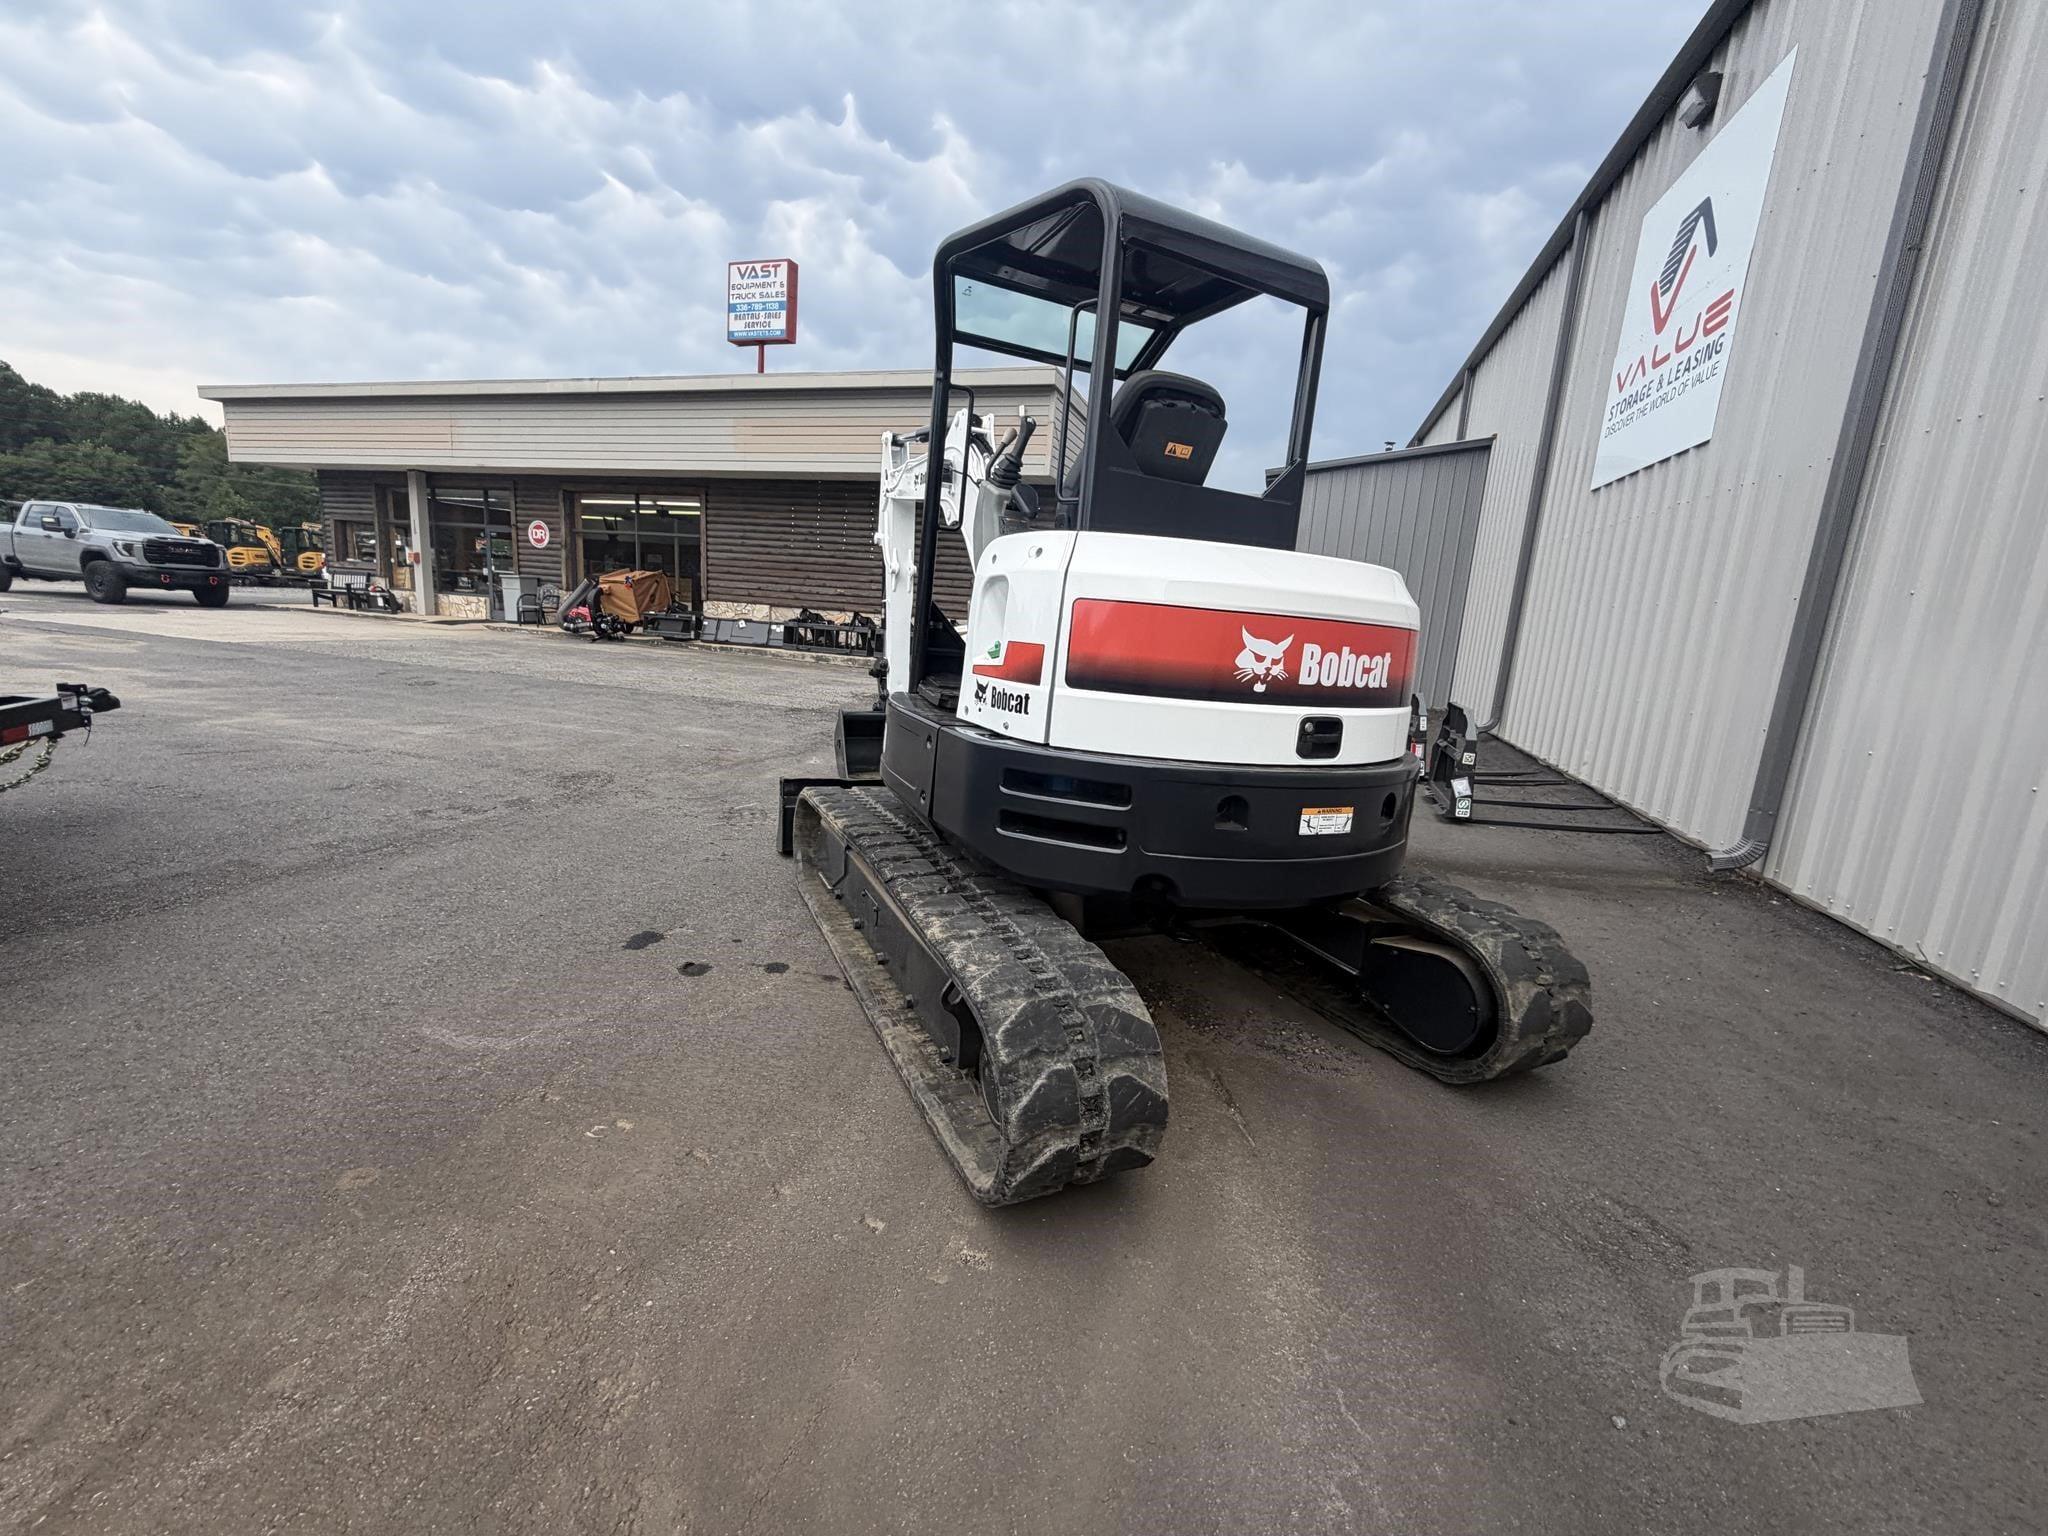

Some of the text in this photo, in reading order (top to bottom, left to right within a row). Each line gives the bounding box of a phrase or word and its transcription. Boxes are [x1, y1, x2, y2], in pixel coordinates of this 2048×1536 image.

[737, 264, 781, 280] VAST
[731, 281, 777, 290] EQUIPMENT
[731, 290, 786, 301] TRUCK SALES
[743, 320, 772, 329] SERVICE
[1616, 287, 1735, 393] VALUE
[1608, 332, 1726, 422] STORAGE & LEASING
[1604, 360, 1720, 439] DISCOVER THE WORLD OF VALUE
[532, 528, 546, 540] DR
[1298, 643, 1392, 689] Bobcat
[990, 686, 1031, 715] Bobcat
